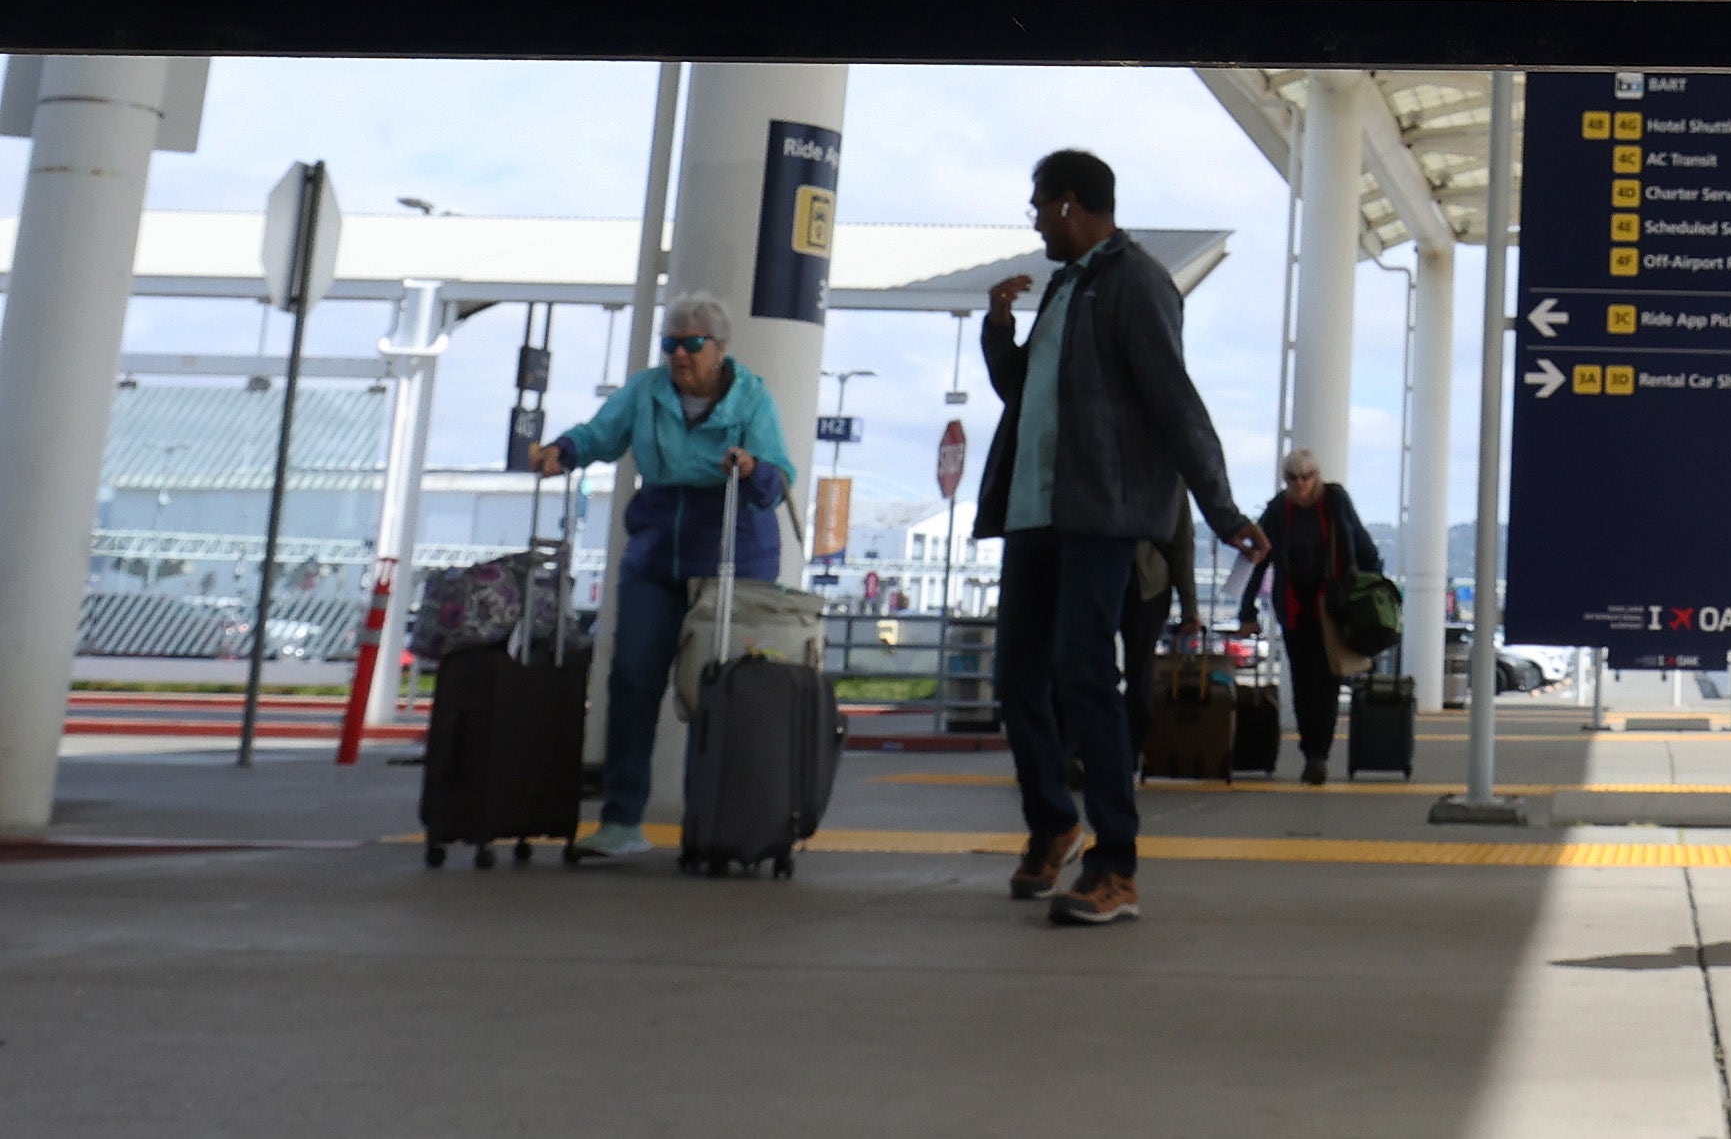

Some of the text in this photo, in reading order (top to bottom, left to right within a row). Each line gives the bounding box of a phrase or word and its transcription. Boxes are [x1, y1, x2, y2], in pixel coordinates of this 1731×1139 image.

[1648, 77, 1687, 92] BART
[1646, 119, 1687, 134] Hotel
[782, 137, 823, 161] Ride
[1646, 151, 1668, 167] AC
[1669, 152, 1718, 168] Transit
[1644, 185, 1700, 201] Charter
[1644, 219, 1719, 236] Scheduled
[1642, 253, 1724, 272] Off-Airport
[1640, 311, 1674, 327] Ride
[1676, 312, 1708, 330] App
[1638, 372, 1686, 388] Rental
[1688, 373, 1715, 389] Car
[1647, 605, 1663, 631] I
